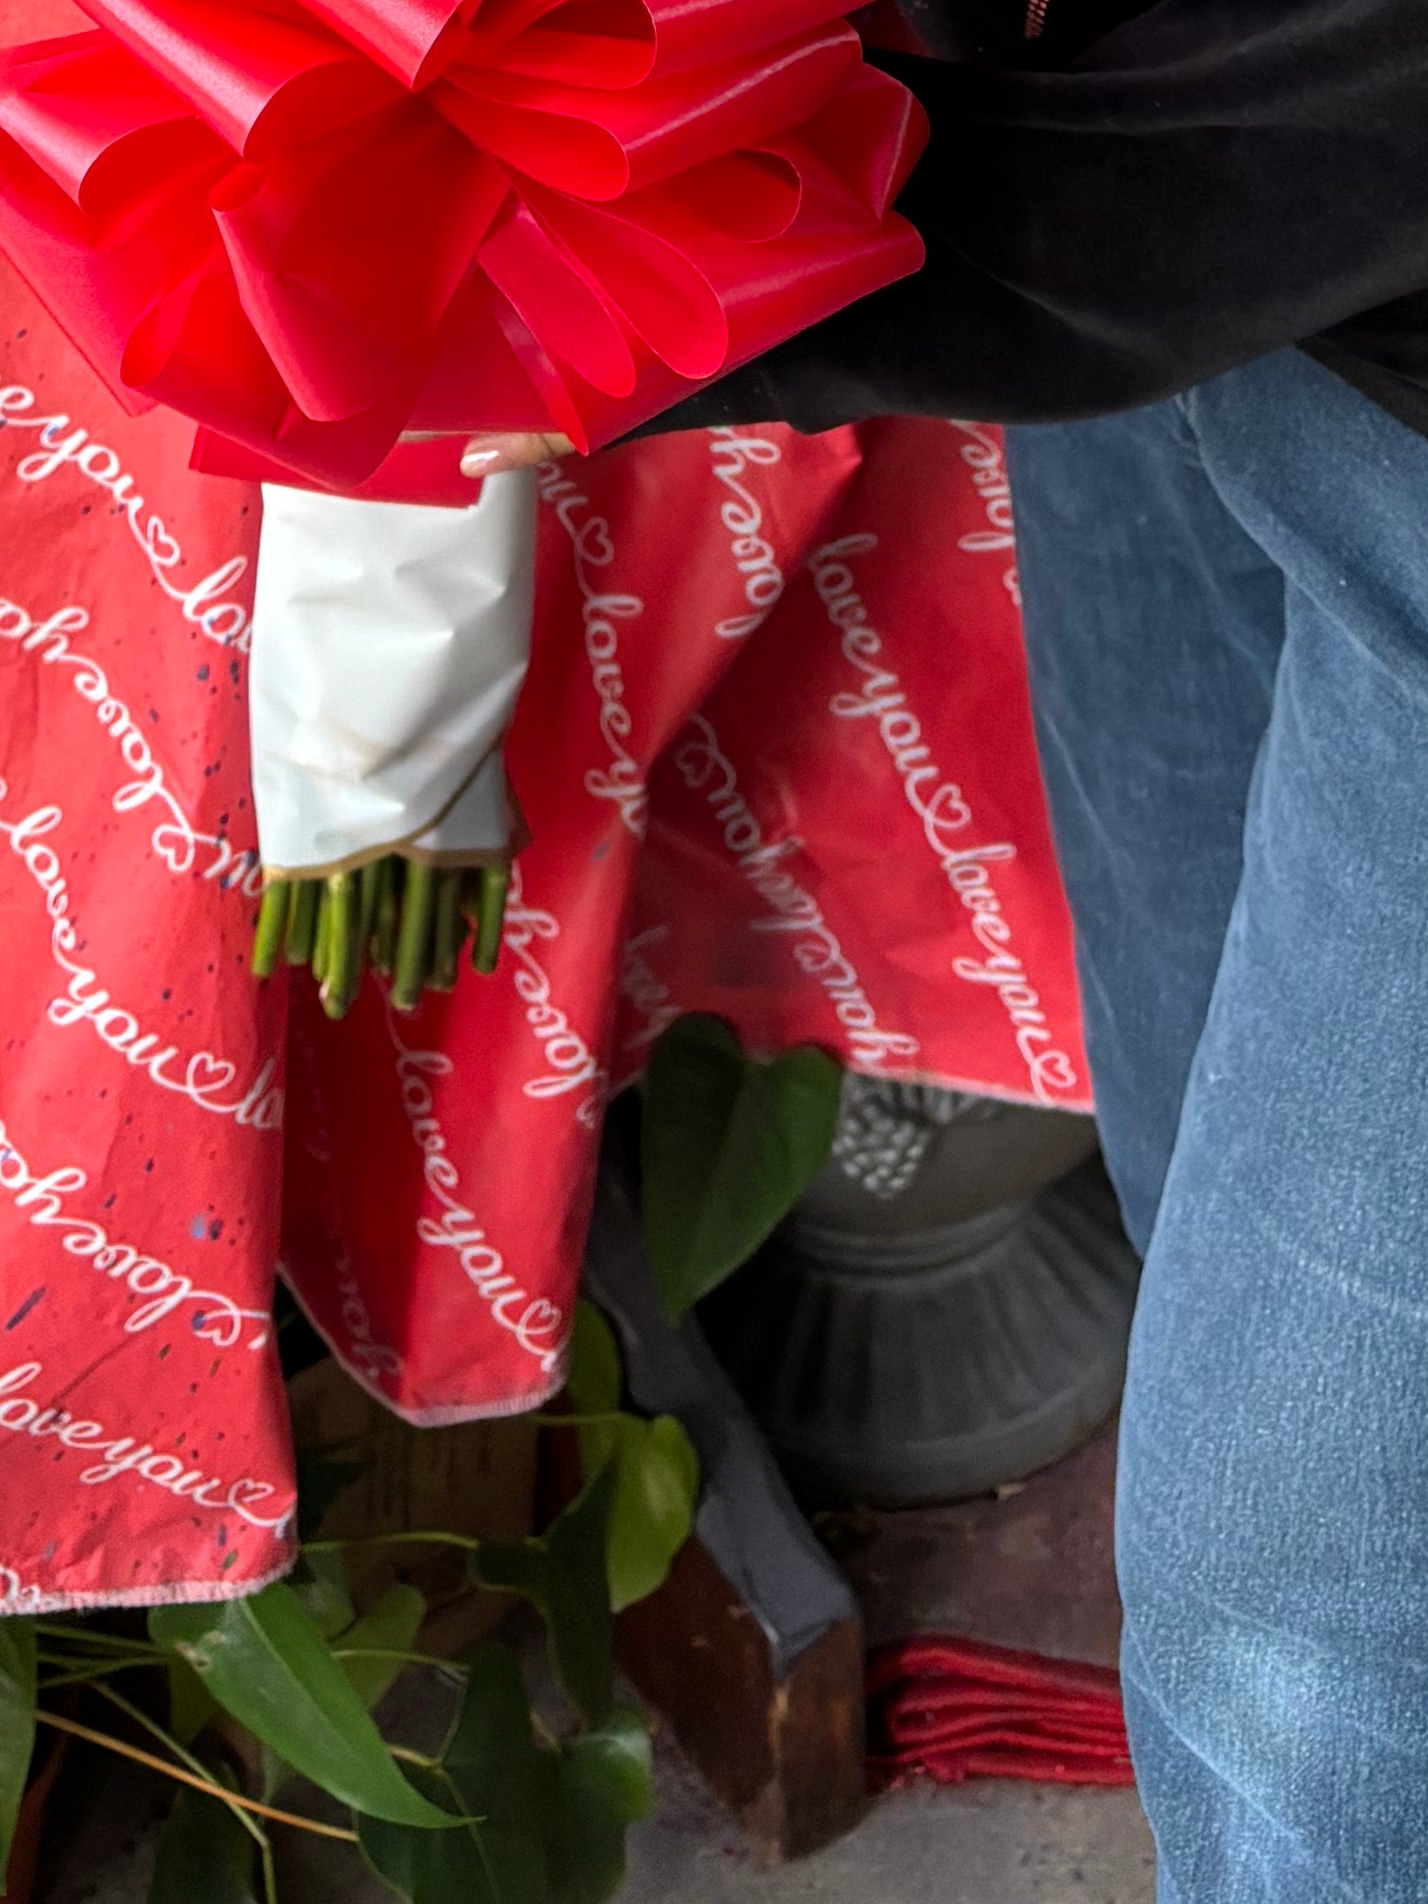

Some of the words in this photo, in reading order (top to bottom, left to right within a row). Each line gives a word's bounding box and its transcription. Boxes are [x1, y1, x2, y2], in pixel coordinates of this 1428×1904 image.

[17, 415, 144, 508] you
[714, 494, 785, 639] love
[805, 532, 882, 665] love
[582, 593, 645, 739] love
[74, 666, 164, 813] love
[829, 674, 940, 804] you
[10, 806, 76, 957] love
[48, 970, 178, 1077] you
[942, 844, 1018, 944] love
[514, 962, 597, 1099] love
[952, 954, 1052, 1054] you
[398, 1050, 459, 1195] love
[63, 1220, 193, 1333] love
[417, 1207, 527, 1320] you
[79, 1438, 222, 1505] you
